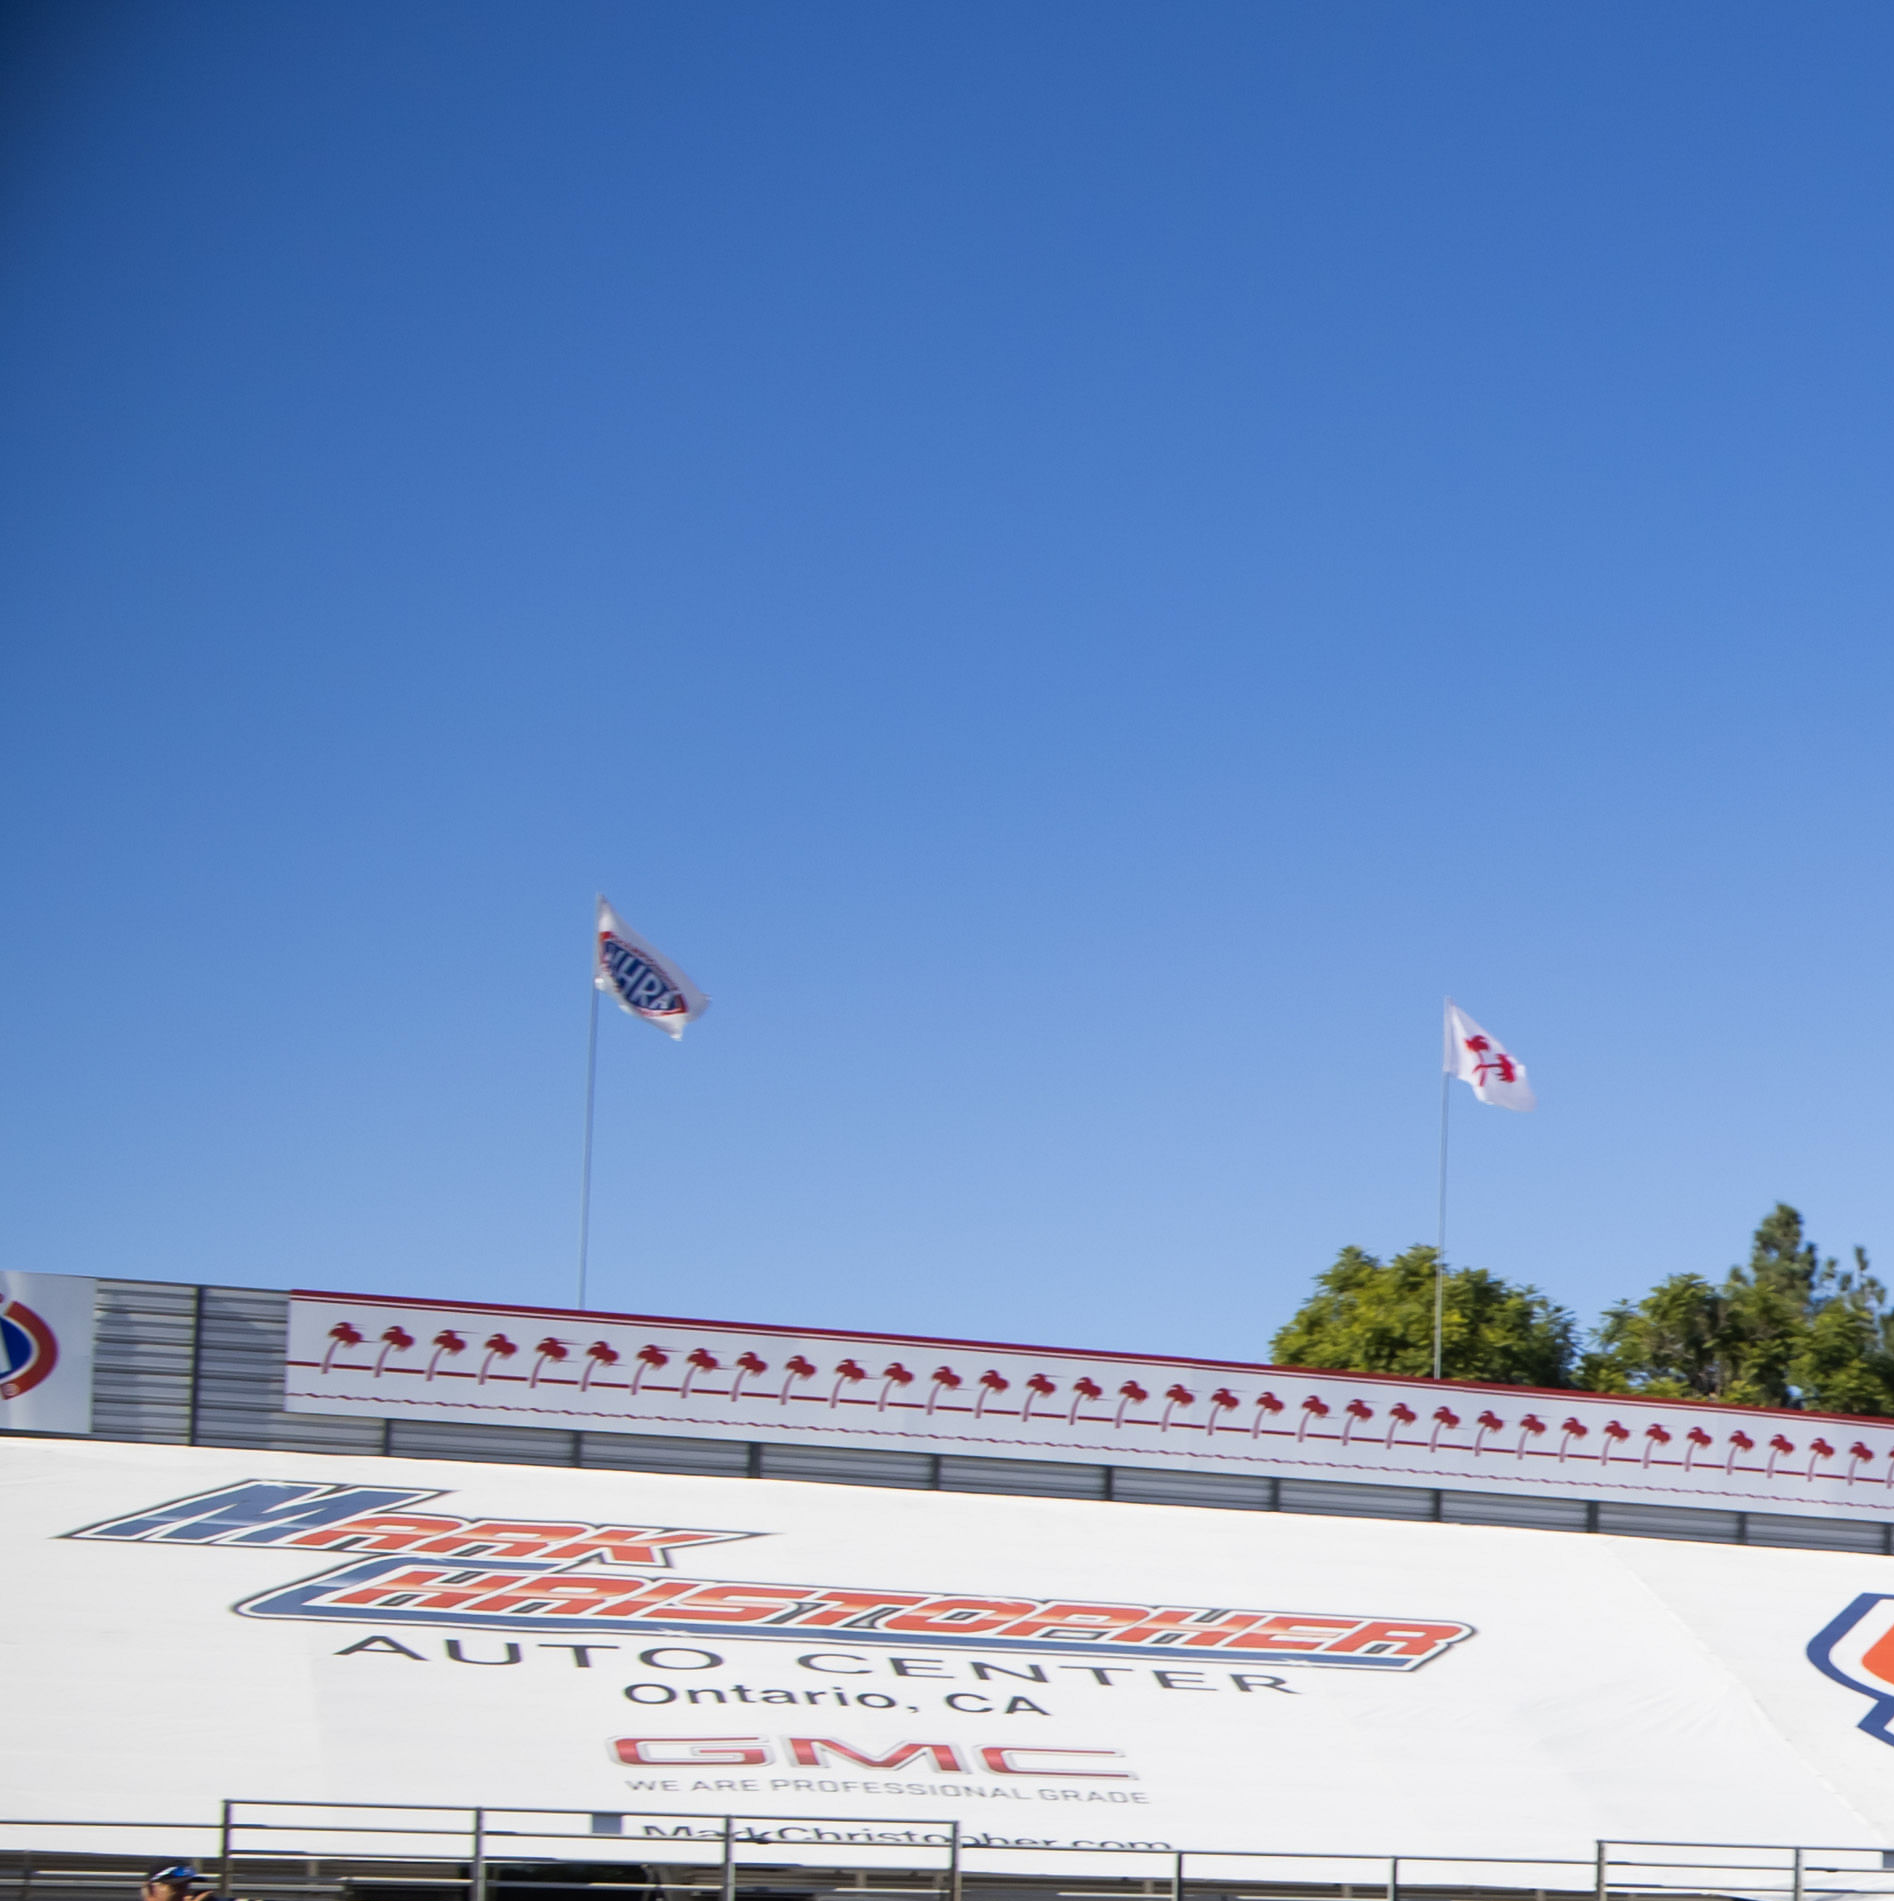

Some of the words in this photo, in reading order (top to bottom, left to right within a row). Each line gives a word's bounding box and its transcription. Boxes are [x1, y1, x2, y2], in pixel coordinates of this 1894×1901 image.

[53, 1480, 780, 1568] MARK
[231, 1554, 1477, 1671] CHRISTOPHER
[332, 1634, 724, 1670] AUTO
[796, 1651, 1303, 1696] CENTER
[623, 1682, 920, 1717] Ontario,
[944, 1691, 1053, 1717] CA
[606, 1734, 1141, 1782] GMC
[623, 1779, 681, 1794] WE
[690, 1778, 761, 1794] ARE
[772, 1778, 1034, 1802] PROFESSIONAL
[1039, 1788, 1151, 1805] GRADE
